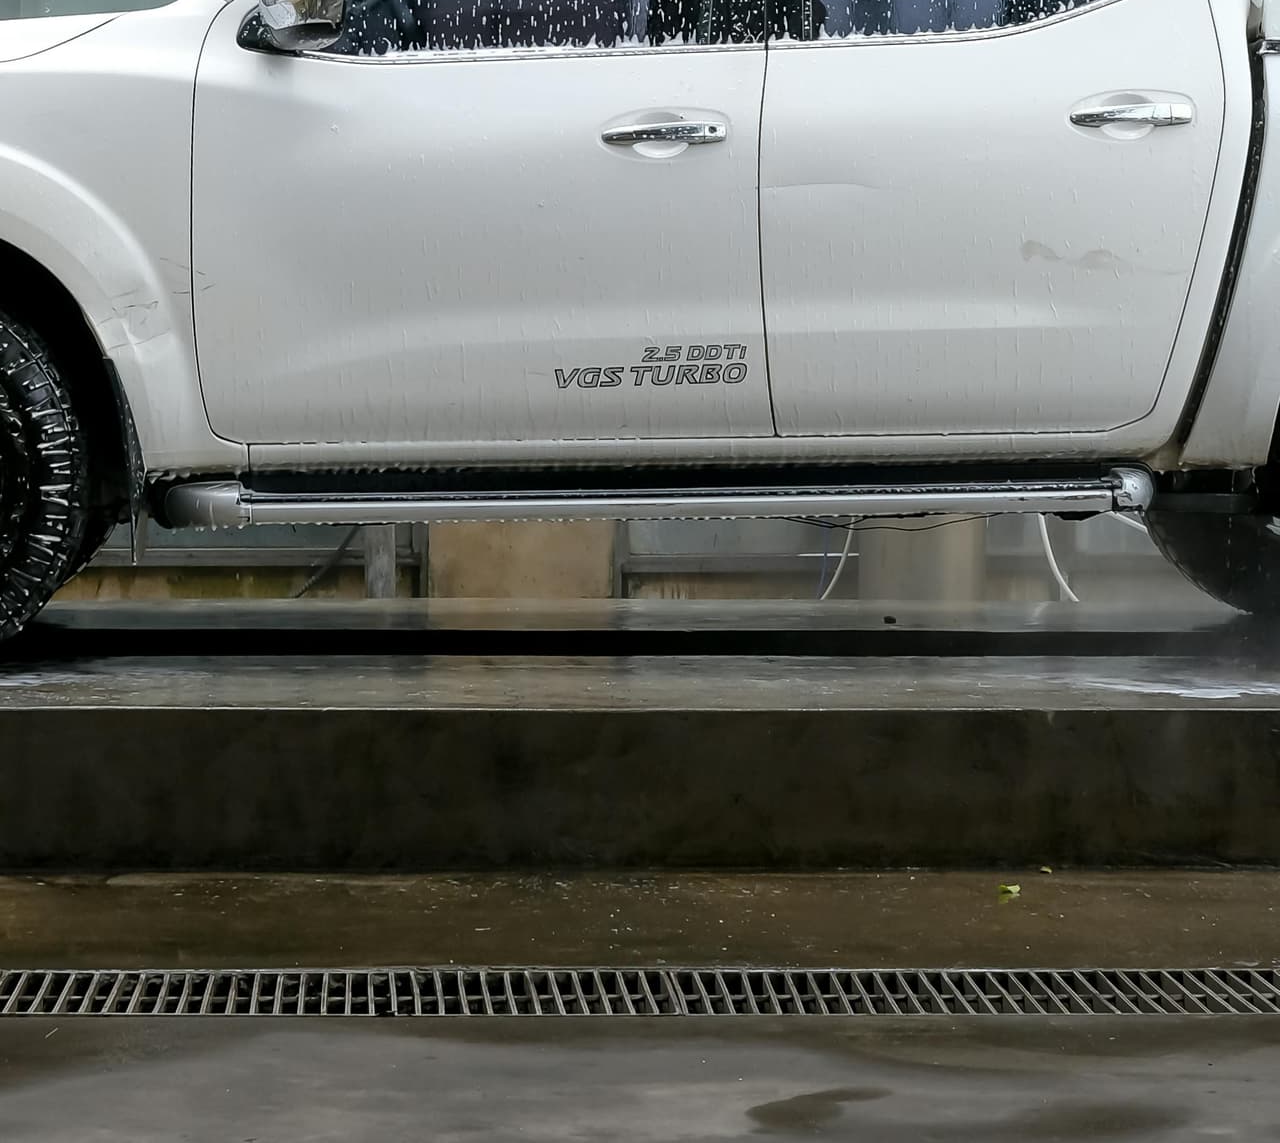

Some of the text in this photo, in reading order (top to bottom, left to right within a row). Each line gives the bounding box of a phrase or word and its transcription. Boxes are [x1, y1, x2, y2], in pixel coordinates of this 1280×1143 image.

[641, 344, 747, 363] 2.5 DDTi
[554, 362, 748, 389] VGS TURBO
